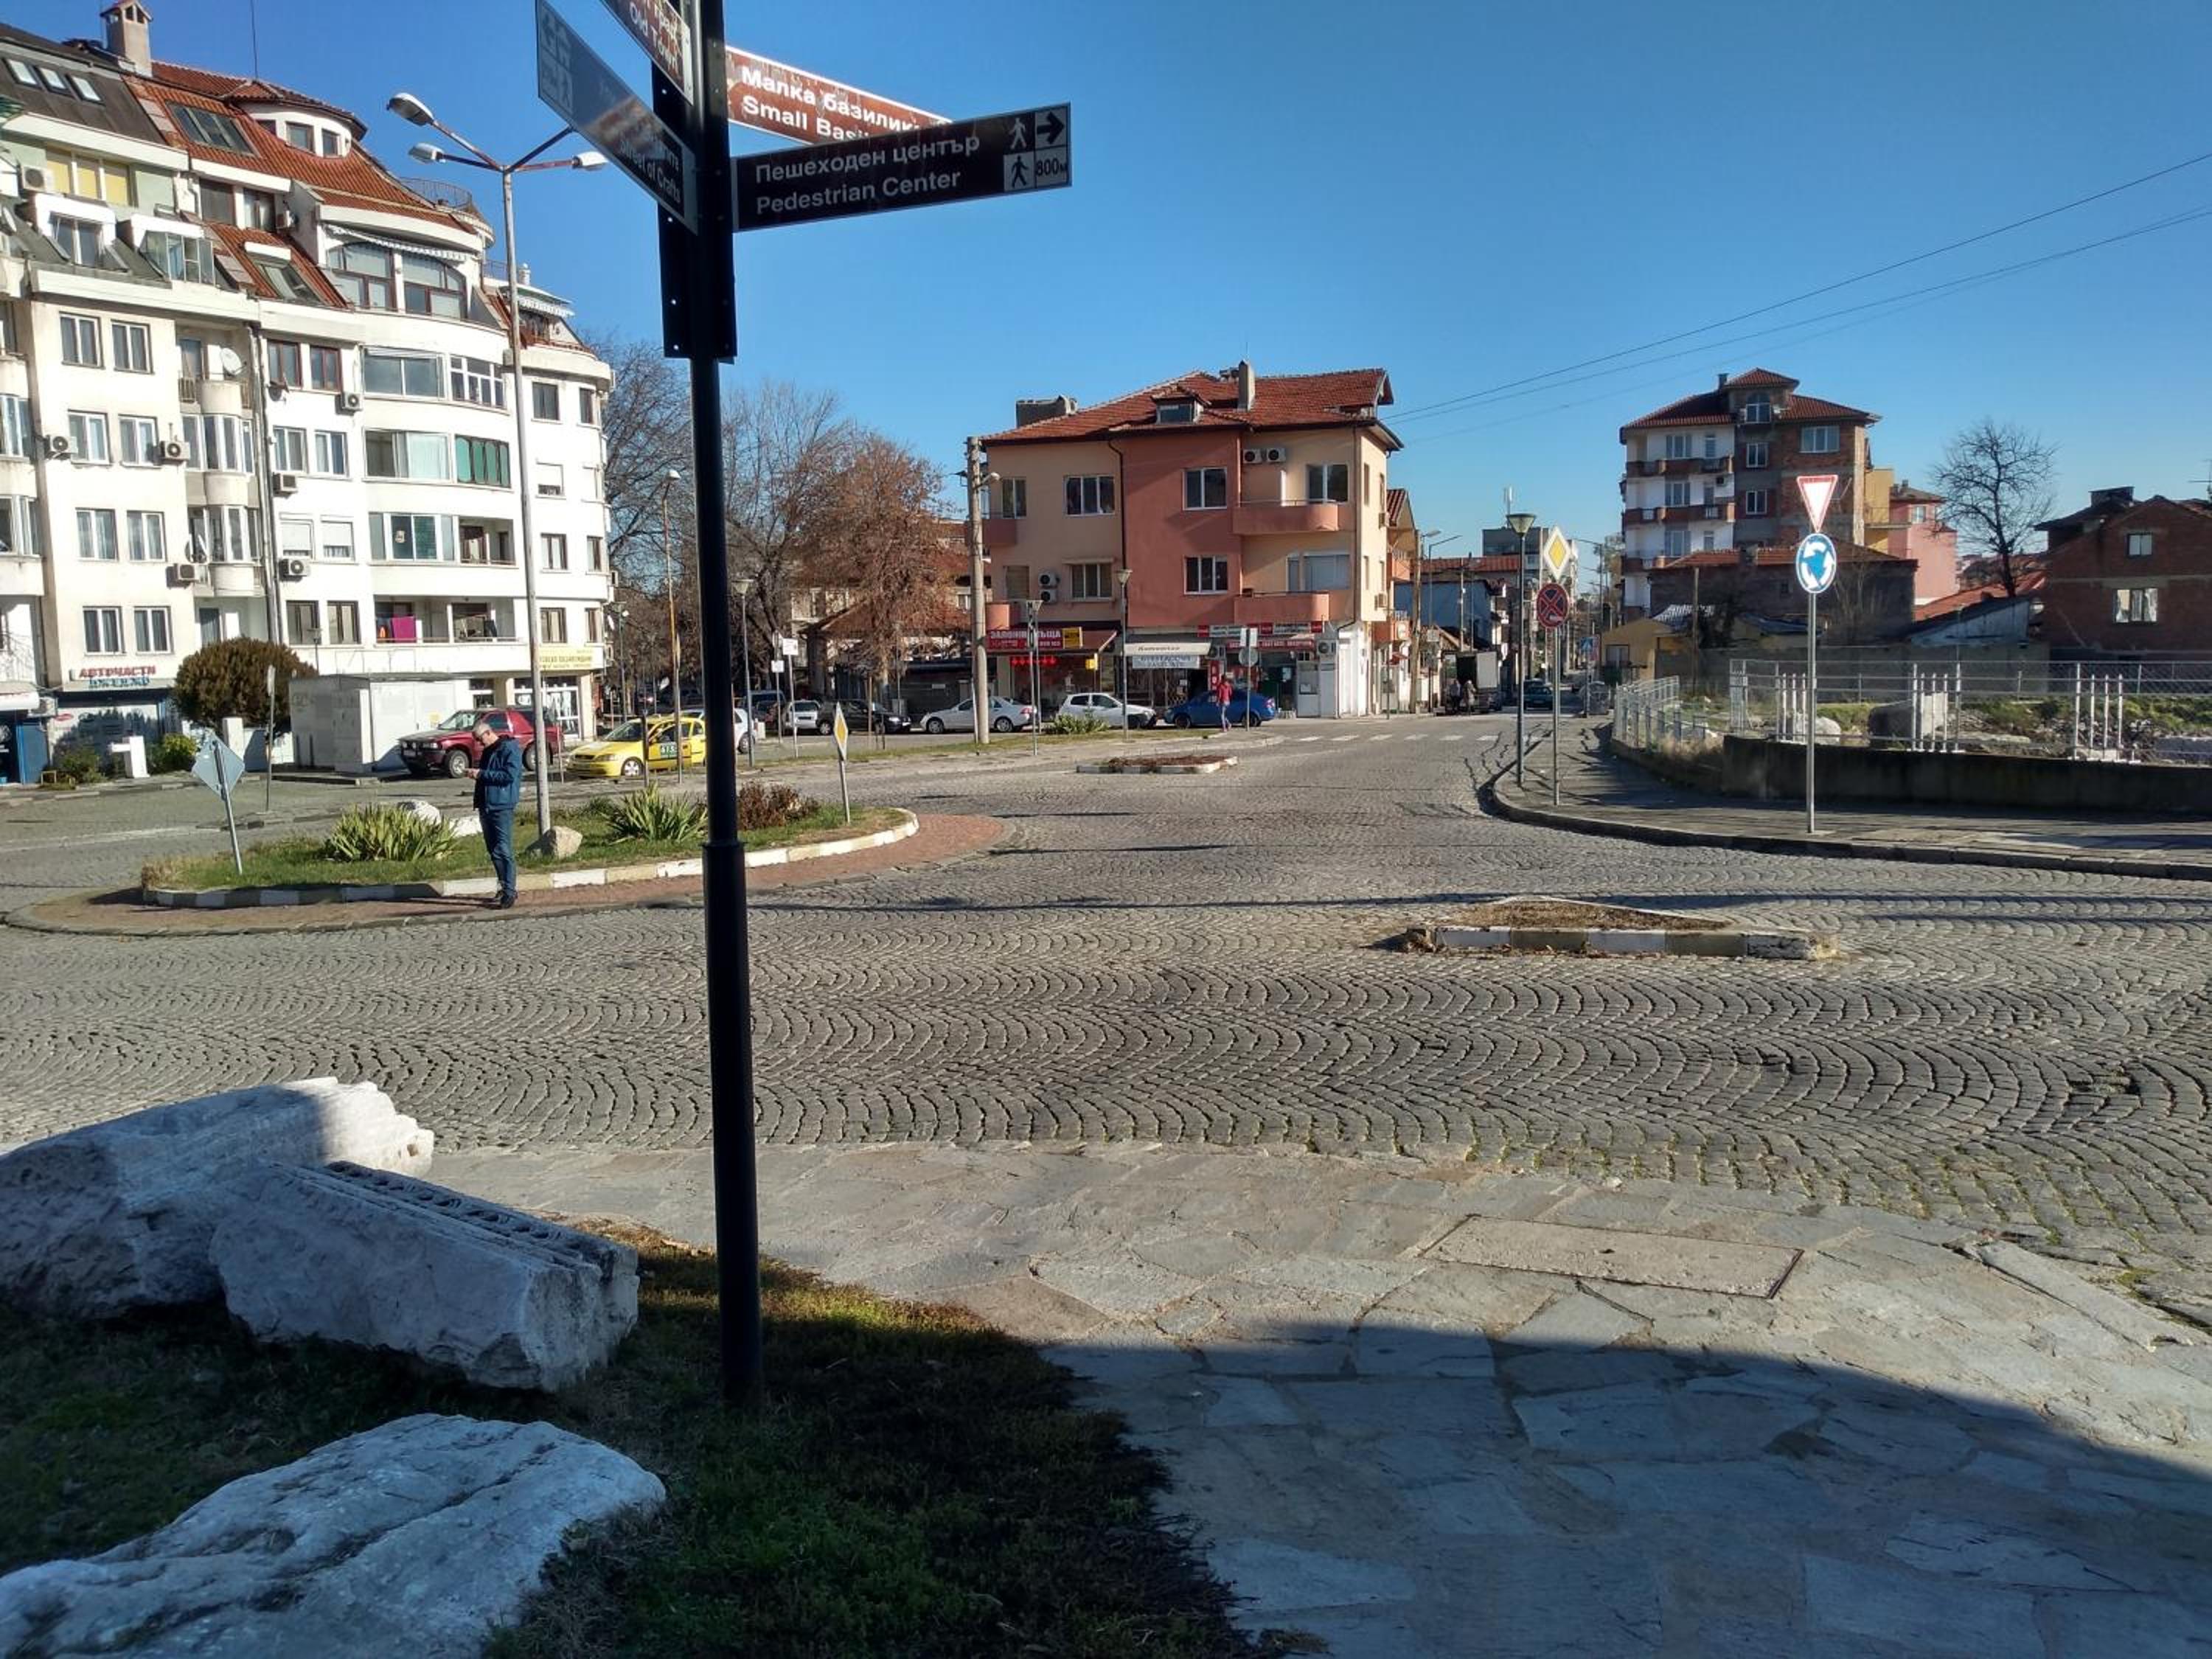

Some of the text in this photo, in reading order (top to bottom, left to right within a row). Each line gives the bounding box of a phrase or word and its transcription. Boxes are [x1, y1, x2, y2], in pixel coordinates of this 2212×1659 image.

[629, 1, 680, 74] Old Town
[741, 66, 921, 133] Малка базилик
[742, 94, 808, 131] Small
[755, 135, 981, 184] Пешеходен център
[657, 166, 681, 204] Crafts
[756, 171, 961, 215] Pedestrian Center
